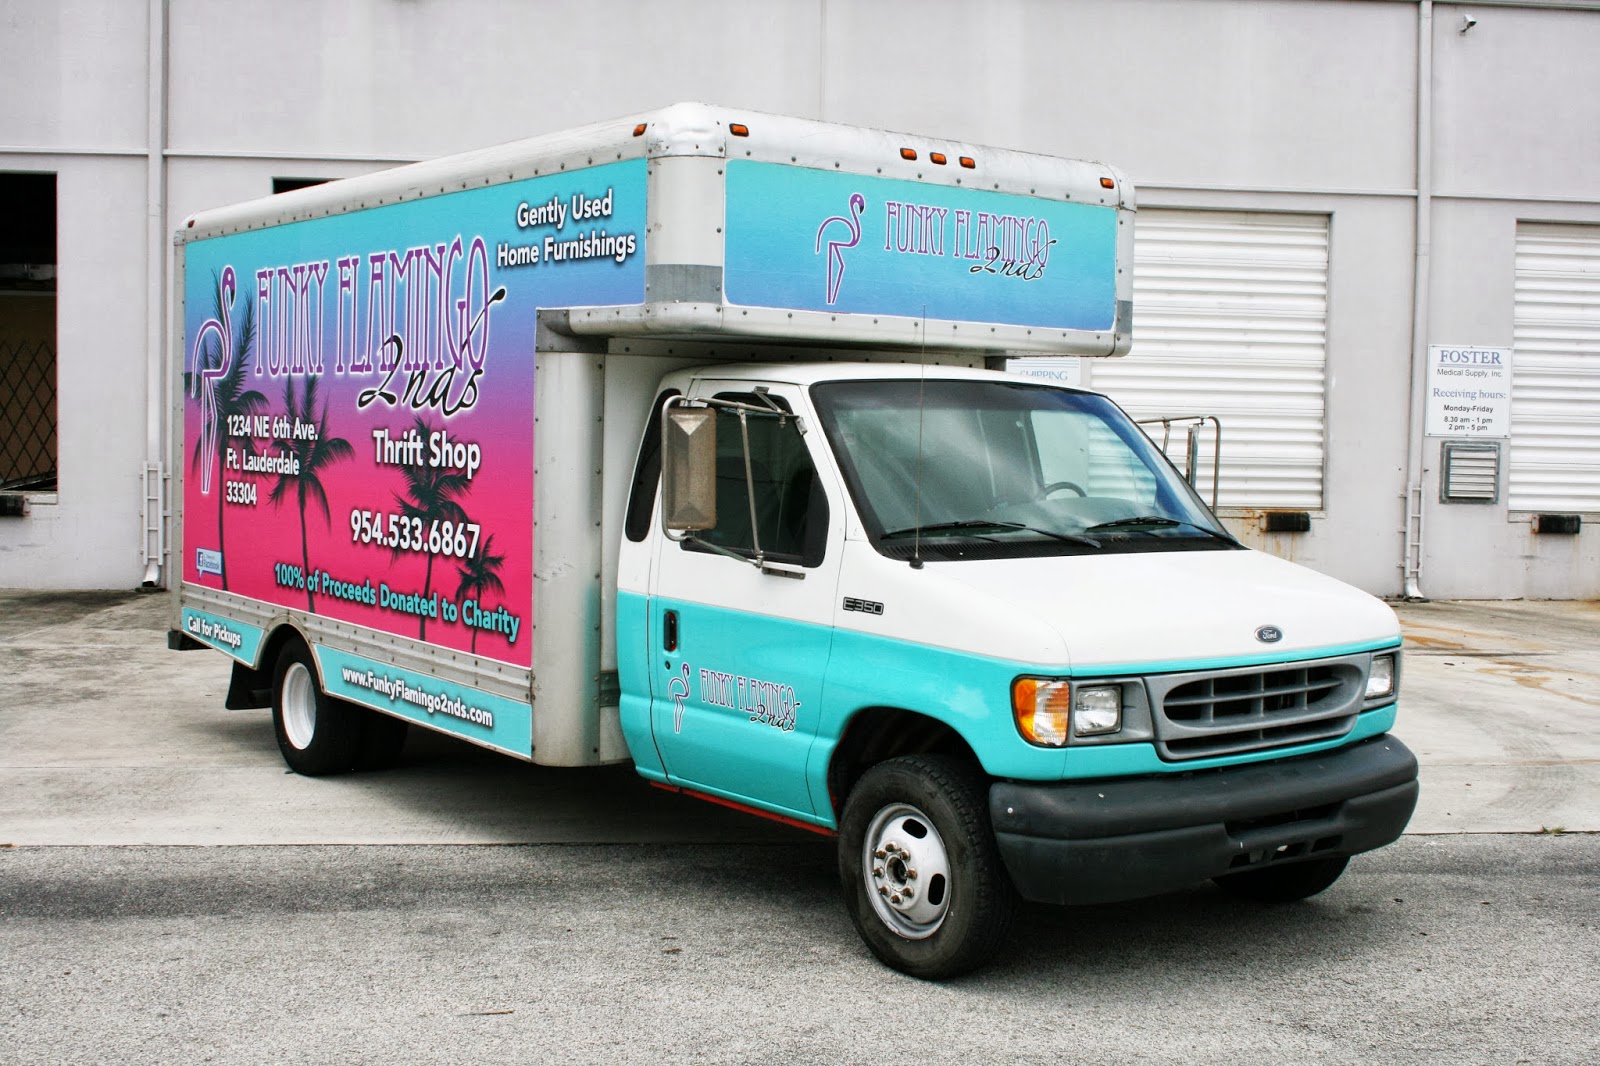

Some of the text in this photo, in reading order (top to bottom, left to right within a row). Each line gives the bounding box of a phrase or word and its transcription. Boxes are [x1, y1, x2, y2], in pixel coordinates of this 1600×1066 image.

[516, 188, 613, 230] Gently Used
[497, 230, 636, 268] Home Furnishings
[884, 201, 1050, 267] FUNKY FLAMINGO
[969, 239, 1058, 281] 2nds
[255, 234, 491, 376] FUNKY FLAMINGO
[358, 287, 507, 417] 2nds
[1439, 350, 1502, 364] FOSTER
[1436, 368, 1464, 376] Medical
[1433, 388, 1506, 400] Receiving hours:
[1443, 405, 1494, 413] Monday-Friday
[226, 415, 319, 441] 1234 NE 6th Ave.
[226, 447, 300, 476] Ft. Lauderdale
[372, 428, 482, 480] Thrift Shop
[226, 480, 258, 506] 33304
[350, 509, 481, 559] 954.533.6867
[275, 562, 521, 643] 100% of Proceeds Donated to Charity
[843, 597, 884, 614] E350
[188, 615, 241, 648] Call for Pickups
[1262, 629, 1278, 640] Ford
[342, 667, 493, 728] www.FunkyFlamingo2nds.com
[700, 668, 796, 724] FUNKY FLAMINGO
[750, 701, 801, 732] 2nds
